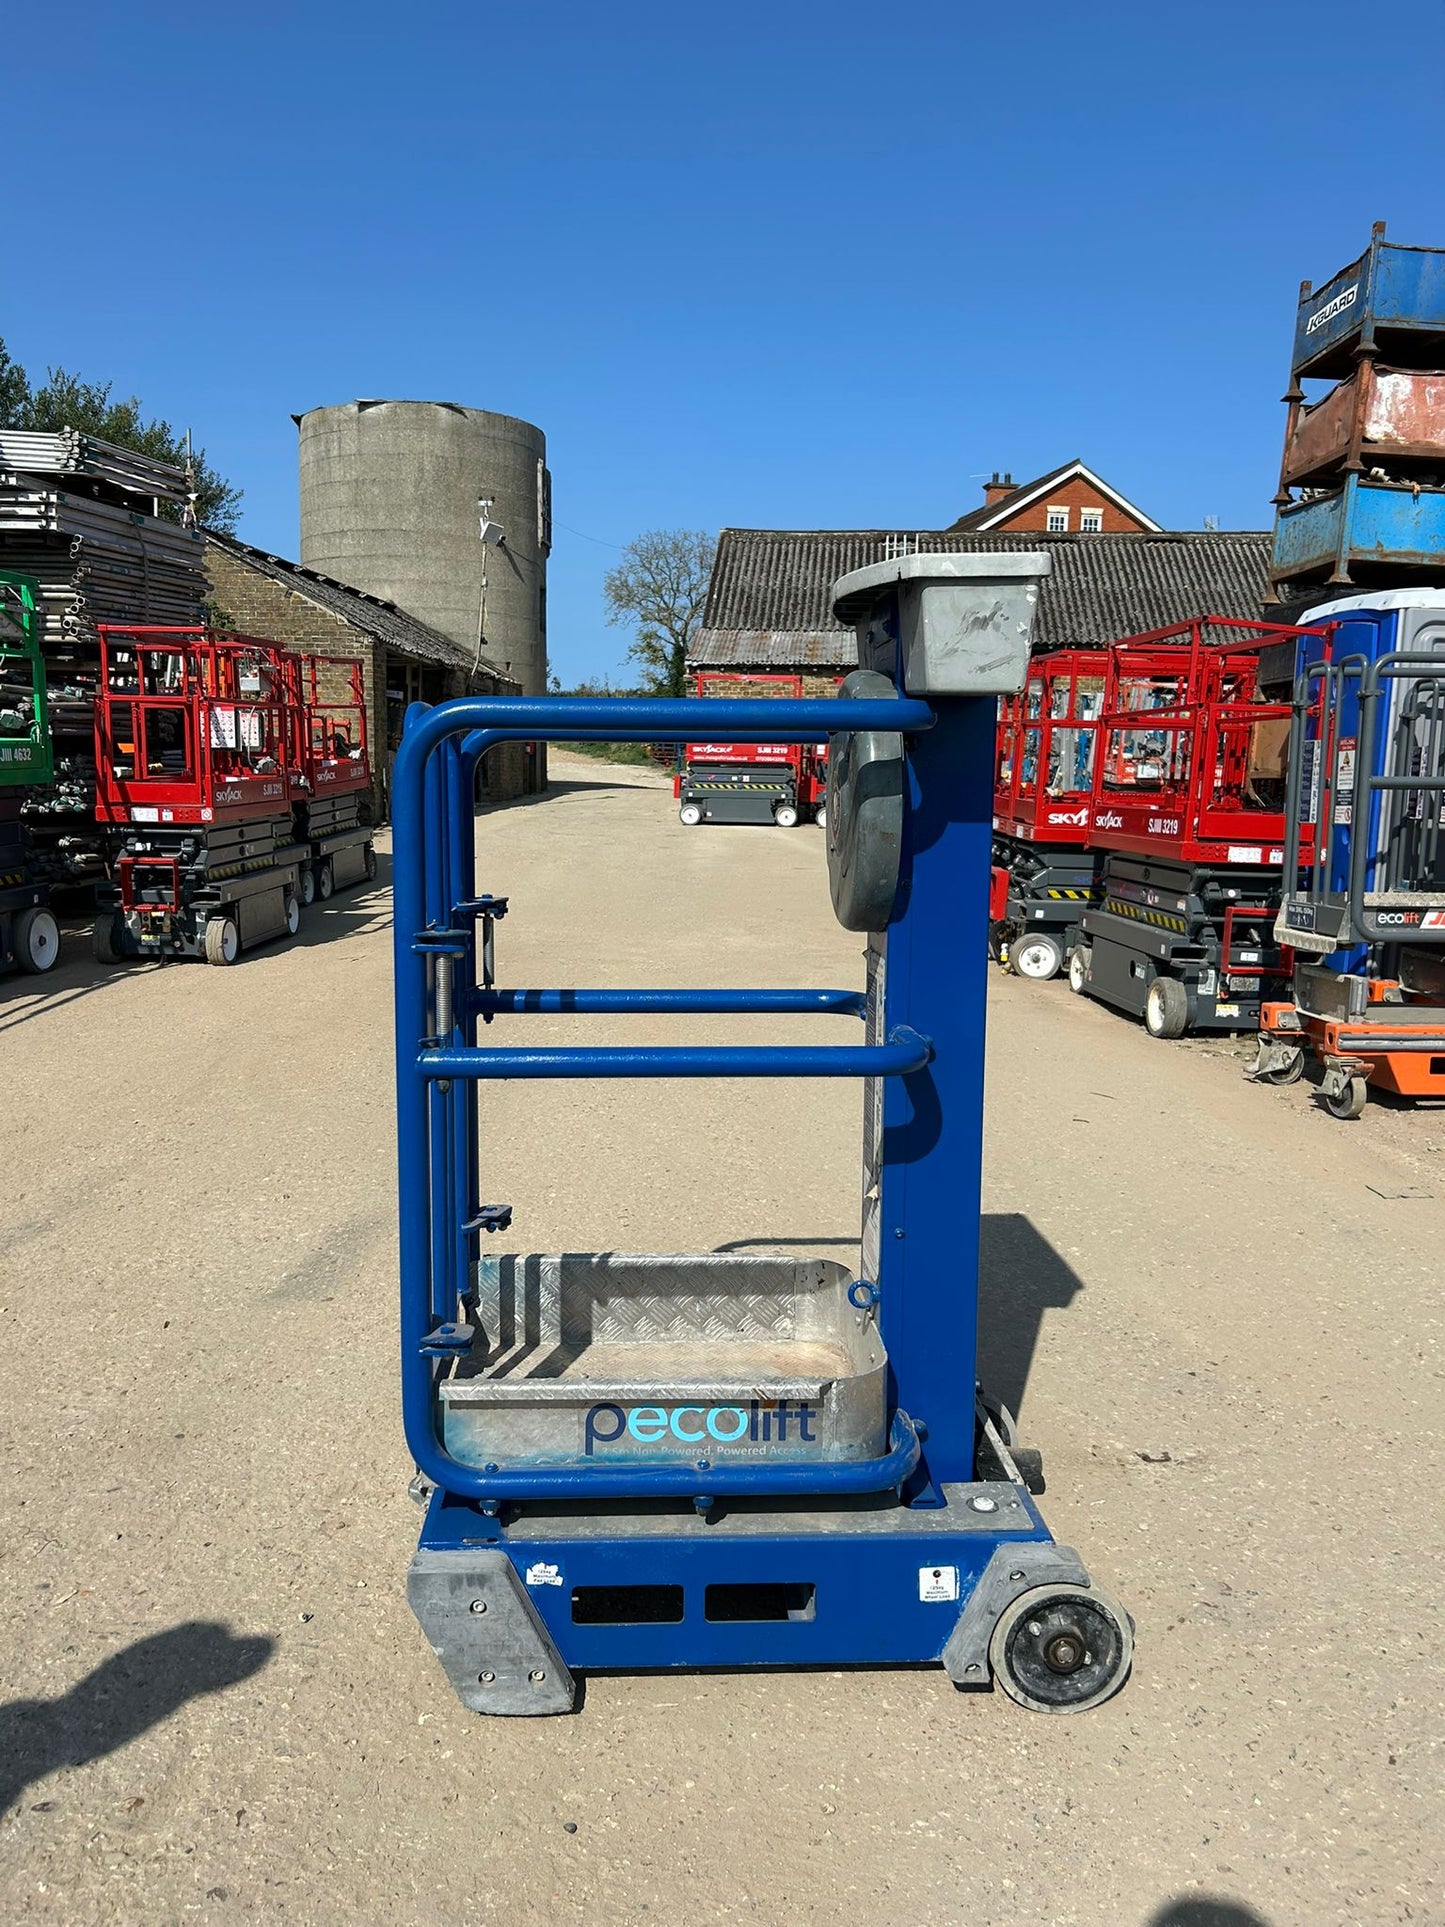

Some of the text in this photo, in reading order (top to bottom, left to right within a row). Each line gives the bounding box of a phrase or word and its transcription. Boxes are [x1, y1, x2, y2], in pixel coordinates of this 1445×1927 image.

[1307, 290, 1355, 331] KGUARD
[0, 748, 12, 761] JIII
[317, 770, 336, 782] SKYJACK
[216, 785, 243, 802] SKYJACK
[1095, 810, 1122, 829] SKYJACK
[1162, 819, 1178, 835] 3219
[1378, 912, 1419, 924] ecolift
[585, 1400, 816, 1455] pecolift
[717, 1446, 766, 1455] Powered
[769, 1446, 807, 1455] Access
